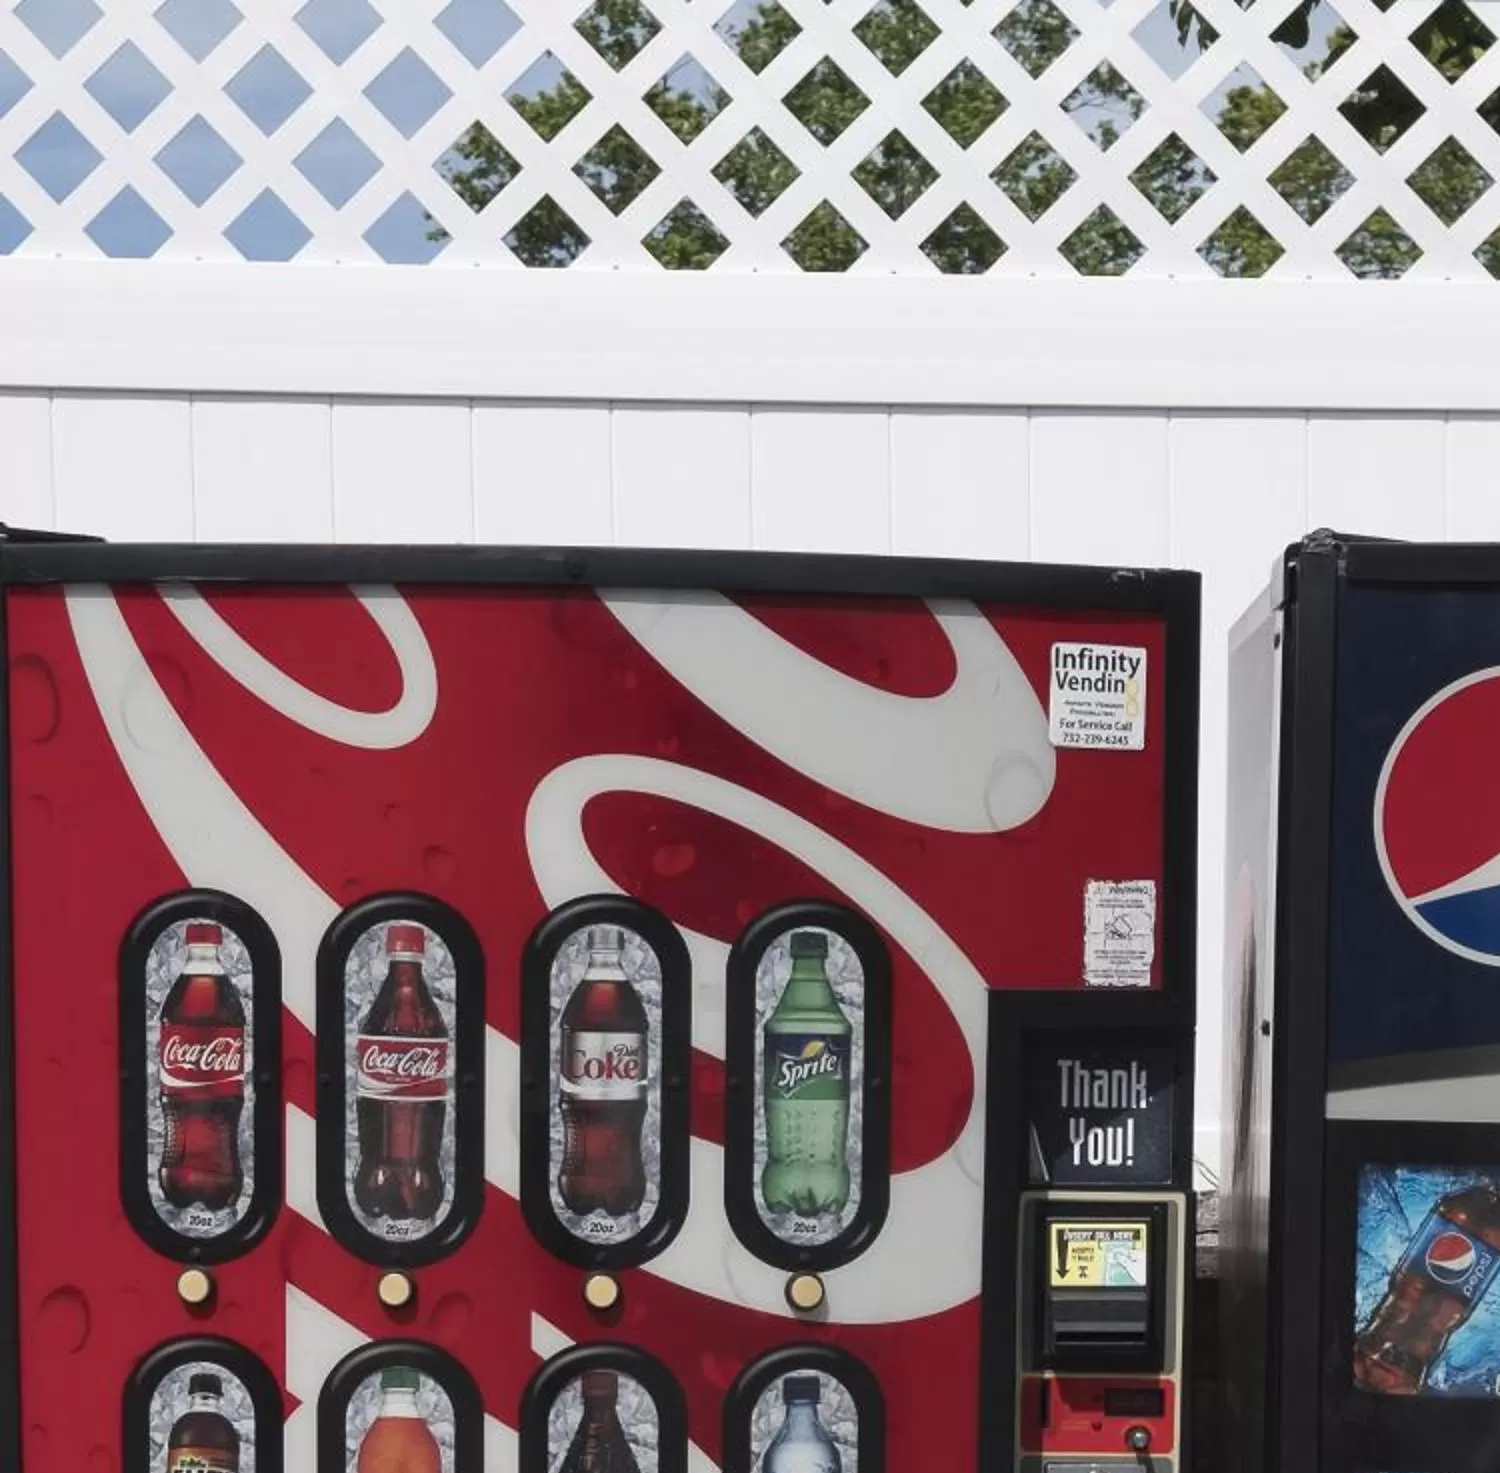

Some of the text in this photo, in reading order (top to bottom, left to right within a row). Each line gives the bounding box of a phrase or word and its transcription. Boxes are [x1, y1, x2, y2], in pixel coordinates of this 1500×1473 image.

[1055, 646, 1141, 679] Infinity
[1059, 718, 1133, 732] For Service Call
[163, 1034, 242, 1072] Coca-Cola
[362, 1045, 446, 1075] Coca-Cola
[572, 1049, 639, 1080] Coke
[778, 1053, 839, 1090] Sprite
[1057, 1059, 1148, 1109] Thank
